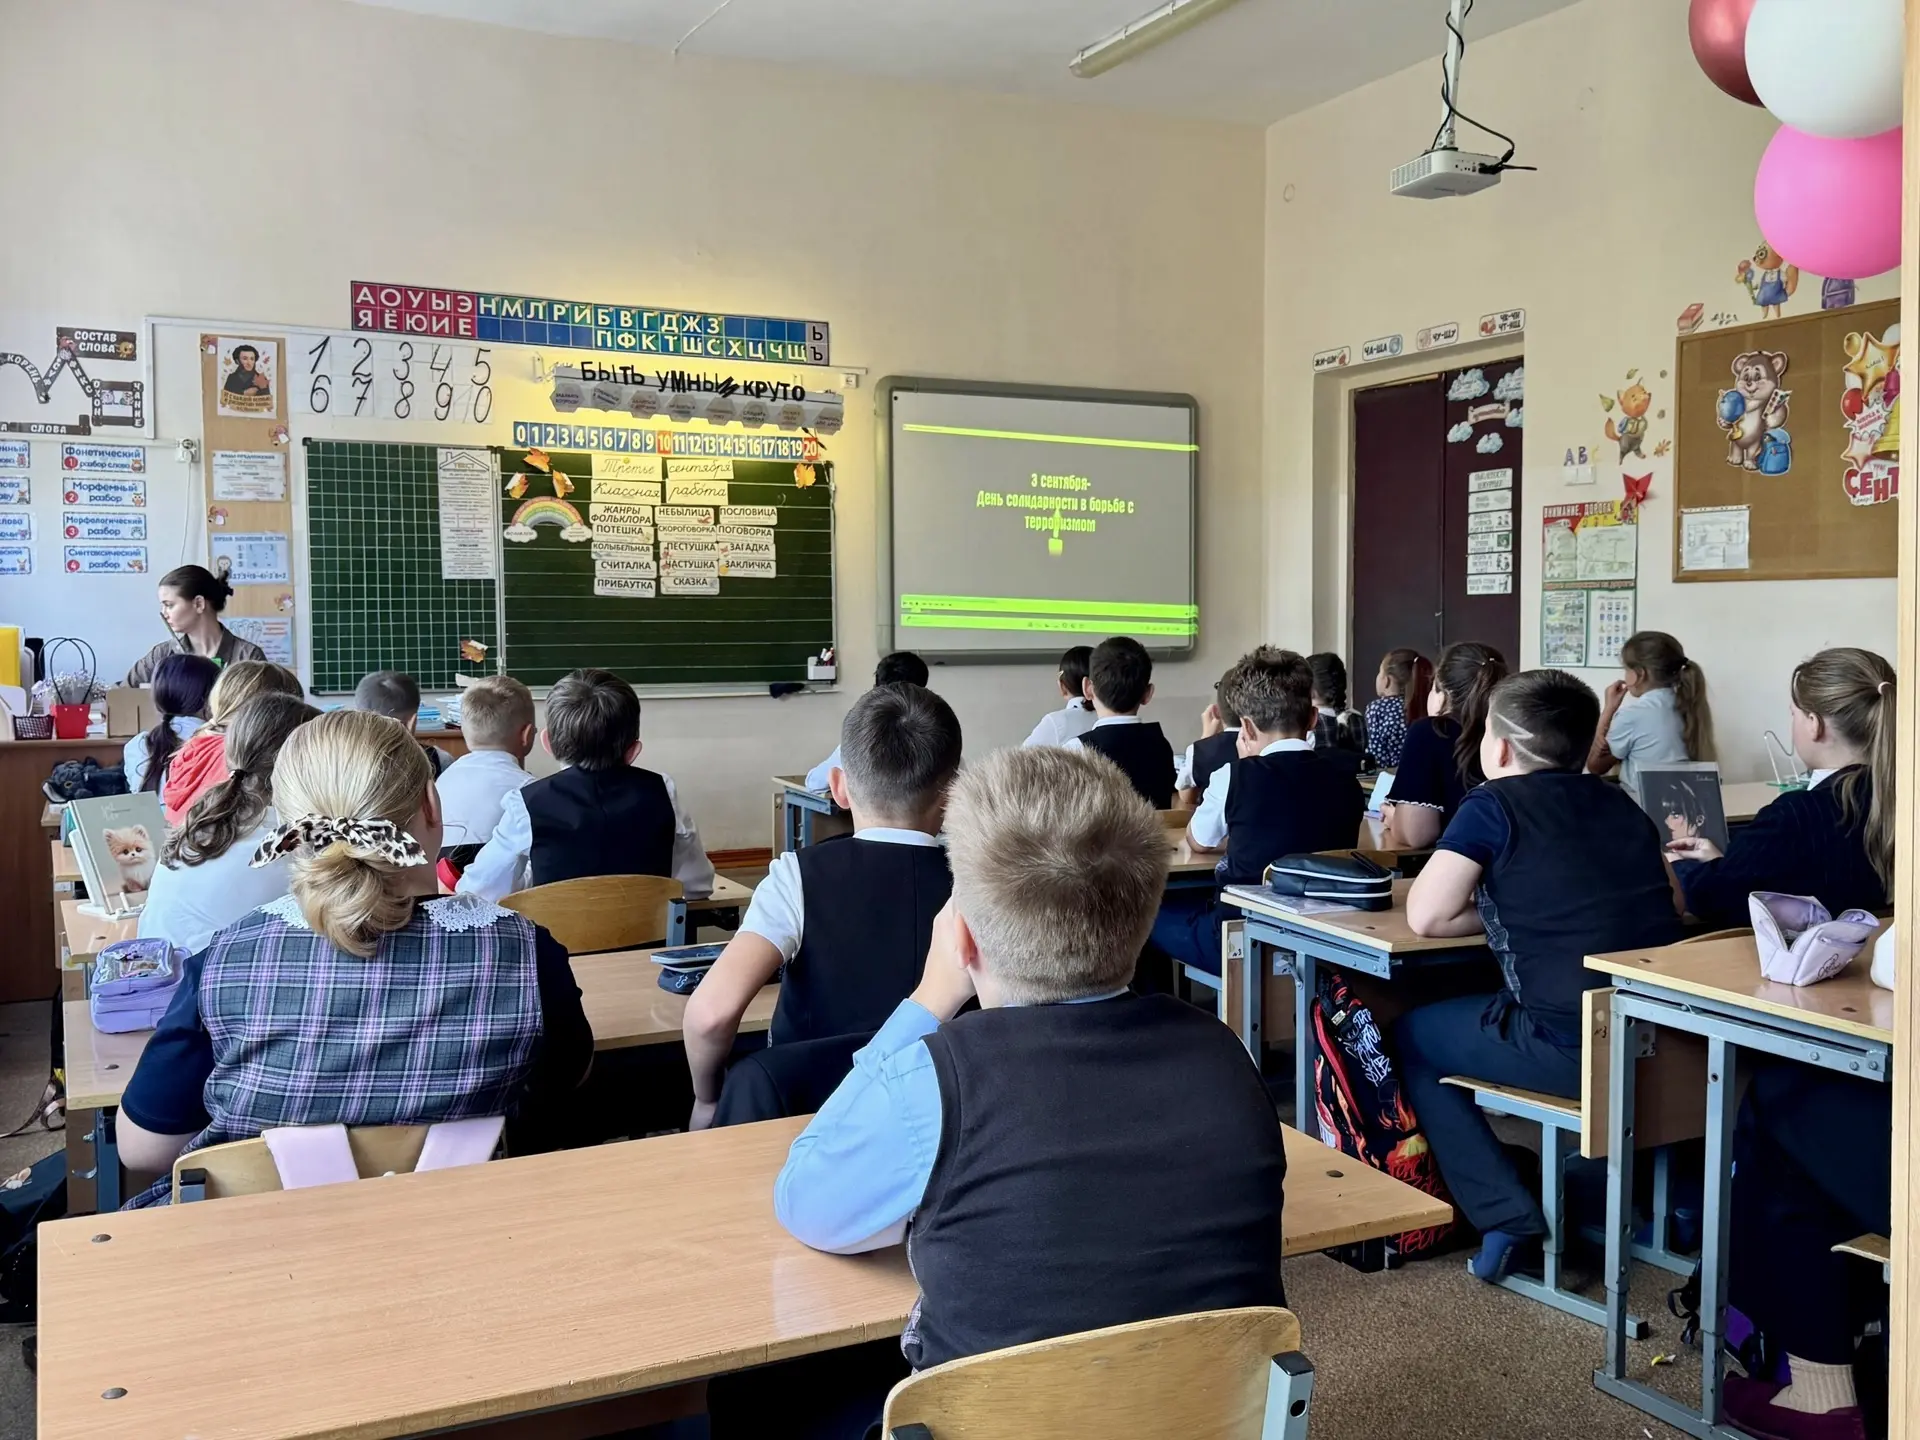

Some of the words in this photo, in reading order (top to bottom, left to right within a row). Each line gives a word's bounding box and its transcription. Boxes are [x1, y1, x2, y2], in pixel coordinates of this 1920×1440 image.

[74, 331, 117, 343] СОСТАВ
[79, 342, 116, 353] СЛОВА
[309, 336, 330, 374] 1
[352, 338, 372, 377] 2
[393, 341, 414, 381] 3
[430, 344, 452, 382] 4
[471, 348, 491, 386] 5
[7, 354, 41, 383] КОРЕНЬ
[581, 361, 645, 385] БЫТЬ
[743, 380, 805, 402] КРУТО
[310, 374, 331, 413] 6
[352, 377, 373, 416] 7
[394, 380, 414, 419] 8
[434, 383, 453, 421] 9
[30, 424, 67, 434] СЛОВА
[517, 425, 526, 442] 0
[532, 427, 539, 443] 1
[546, 427, 555, 444] 2
[561, 428, 570, 445] 3
[575, 429, 584, 446] 4
[590, 430, 598, 447] 5
[604, 431, 613, 448] 6
[618, 432, 627, 449] 7
[632, 432, 641, 449] 8
[645, 433, 654, 450] 9
[658, 435, 670, 450] 10
[673, 436, 685, 452] 11
[688, 436, 701, 453] 12
[703, 437, 716, 454] 13
[718, 437, 732, 454] 14
[733, 438, 746, 455] 15
[748, 439, 761, 456] 16
[763, 439, 775, 456] 17
[777, 439, 789, 456] 18
[790, 440, 802, 456] 19
[804, 441, 817, 458] 20
[65, 446, 140, 458] Фонетический
[80, 460, 106, 469] разбор
[600, 458, 655, 477] Третье
[669, 460, 732, 478] сентября
[1031, 473, 1038, 487] 3
[1040, 474, 1091, 491] сентября-
[72, 482, 138, 493] Морфемный
[593, 483, 661, 499] Классная
[668, 482, 727, 500] работа
[89, 494, 122, 503] разбор
[976, 490, 1003, 508] День
[1006, 494, 1078, 511] солидарности
[1080, 499, 1087, 511] в
[1089, 497, 1126, 514] борьбе
[1127, 501, 1134, 513] с
[603, 505, 641, 515] ЖАНРЫ
[658, 508, 711, 518] НЕБЫЛИЦА
[720, 508, 776, 517] ПОСЛОВИЦА
[66, 516, 143, 525] Морфологический
[590, 514, 651, 524] ФОЛЬКЛОРА
[87, 527, 121, 536] разбор
[596, 525, 643, 535] ПОТЕШКА
[658, 525, 716, 533] СКОРОГОВОРКА
[718, 526, 772, 537] ПОГОВОРКА
[593, 543, 650, 552] КОЛЫБЕЛЬНАЯ
[666, 542, 716, 551] ПЕСТУШКА
[729, 543, 770, 551] ЗАГАДКА
[68, 548, 142, 557] Синтаксический
[88, 561, 120, 569] разбор
[601, 561, 651, 570] СЧИТАЛКА
[665, 560, 716, 569] ЧАСТУШКА
[725, 560, 772, 570] ЗАКЛИЧКА
[597, 579, 653, 590] ПРИБАУТКА
[673, 577, 708, 586] СКАЗКА
